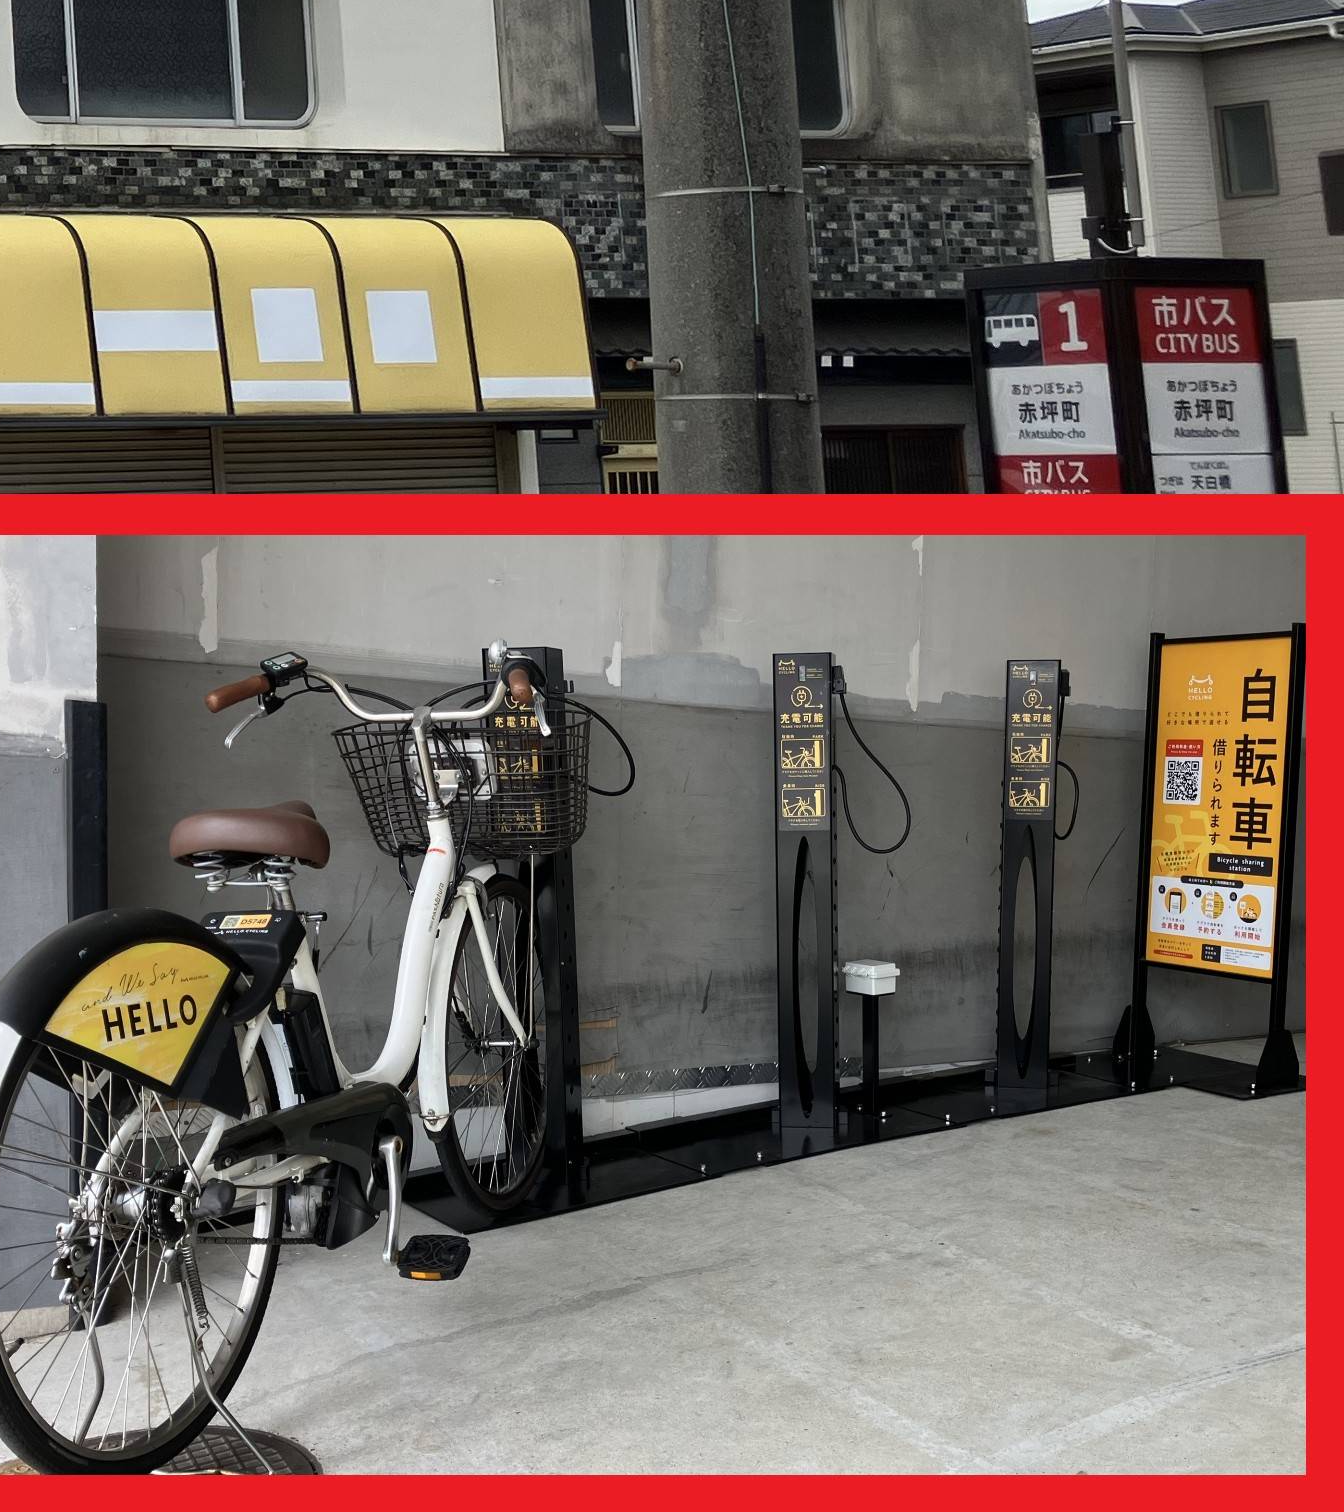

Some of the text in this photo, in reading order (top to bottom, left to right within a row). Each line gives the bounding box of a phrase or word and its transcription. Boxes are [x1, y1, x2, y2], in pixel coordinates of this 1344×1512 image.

[1151, 295, 1236, 328] 市バス
[1058, 300, 1089, 353] 1
[1155, 333, 1240, 355] CITY BUS
[1011, 381, 1084, 396] あかつぼちょう
[1166, 379, 1238, 394] あかつぼちょう
[1018, 400, 1081, 425] 赤坪町
[1173, 399, 1235, 423] 赤坪町
[1018, 428, 1086, 440] Akatsubo-cho
[1173, 426, 1240, 439] Akatsubo-cho
[1021, 460, 1089, 486] 市バス
[779, 713, 824, 724] 充電可能
[1229, 668, 1277, 850] 自転車
[1209, 738, 1227, 846] 借りられます
[1217, 856, 1265, 868] Bicycle sharing
[1229, 865, 1251, 873] station
[120, 971, 145, 997] We
[149, 962, 179, 986] Say
[101, 994, 197, 1043] HELLO
